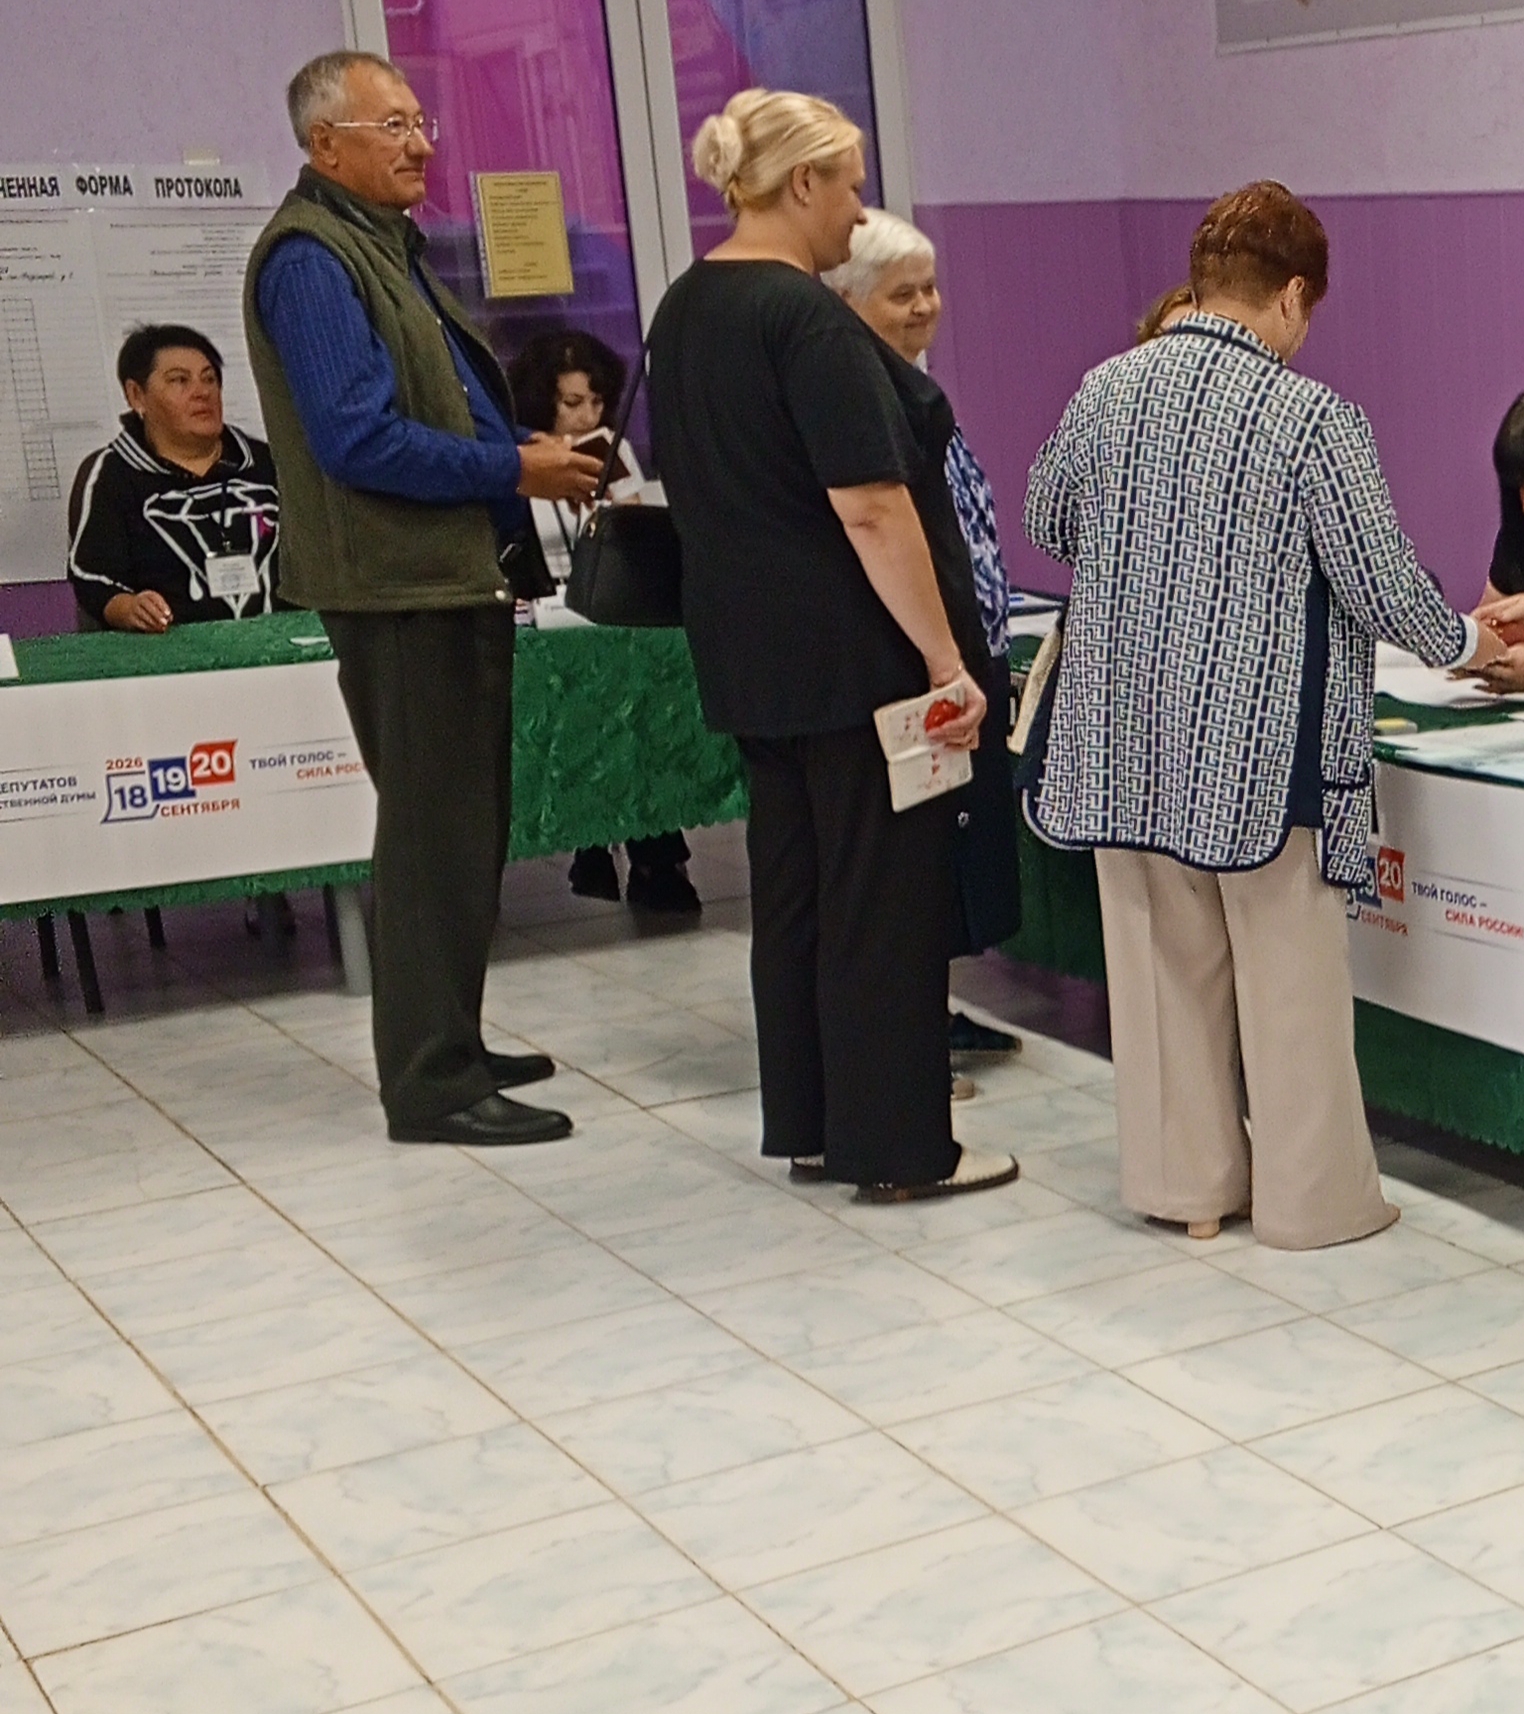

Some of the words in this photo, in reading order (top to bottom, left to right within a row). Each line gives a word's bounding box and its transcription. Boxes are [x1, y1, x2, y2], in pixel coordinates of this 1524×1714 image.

[76, 175, 133, 197] ФОРМА
[155, 178, 243, 198] ПРОТОКОЛА
[106, 757, 143, 770] 2026
[249, 754, 287, 770] ТВОЙ
[290, 751, 334, 766] ГОЛОС
[114, 784, 148, 810] 18
[152, 766, 186, 793] 19
[192, 750, 232, 778] 20
[297, 765, 332, 779] СИЛА
[0, 776, 77, 795] ЕПУТАТОВ
[0, 793, 58, 809] ТВЕННОЙ
[60, 791, 96, 804] ДУМЫ
[161, 798, 240, 817] СЕНТЯБРЯ
[1379, 858, 1402, 890] 20
[1412, 881, 1438, 901] ТВОЙ
[1440, 890, 1477, 908] ГОЛОС
[1360, 909, 1408, 936] СЕНТЯБРЯ
[1445, 909, 1475, 926] СИЛА
